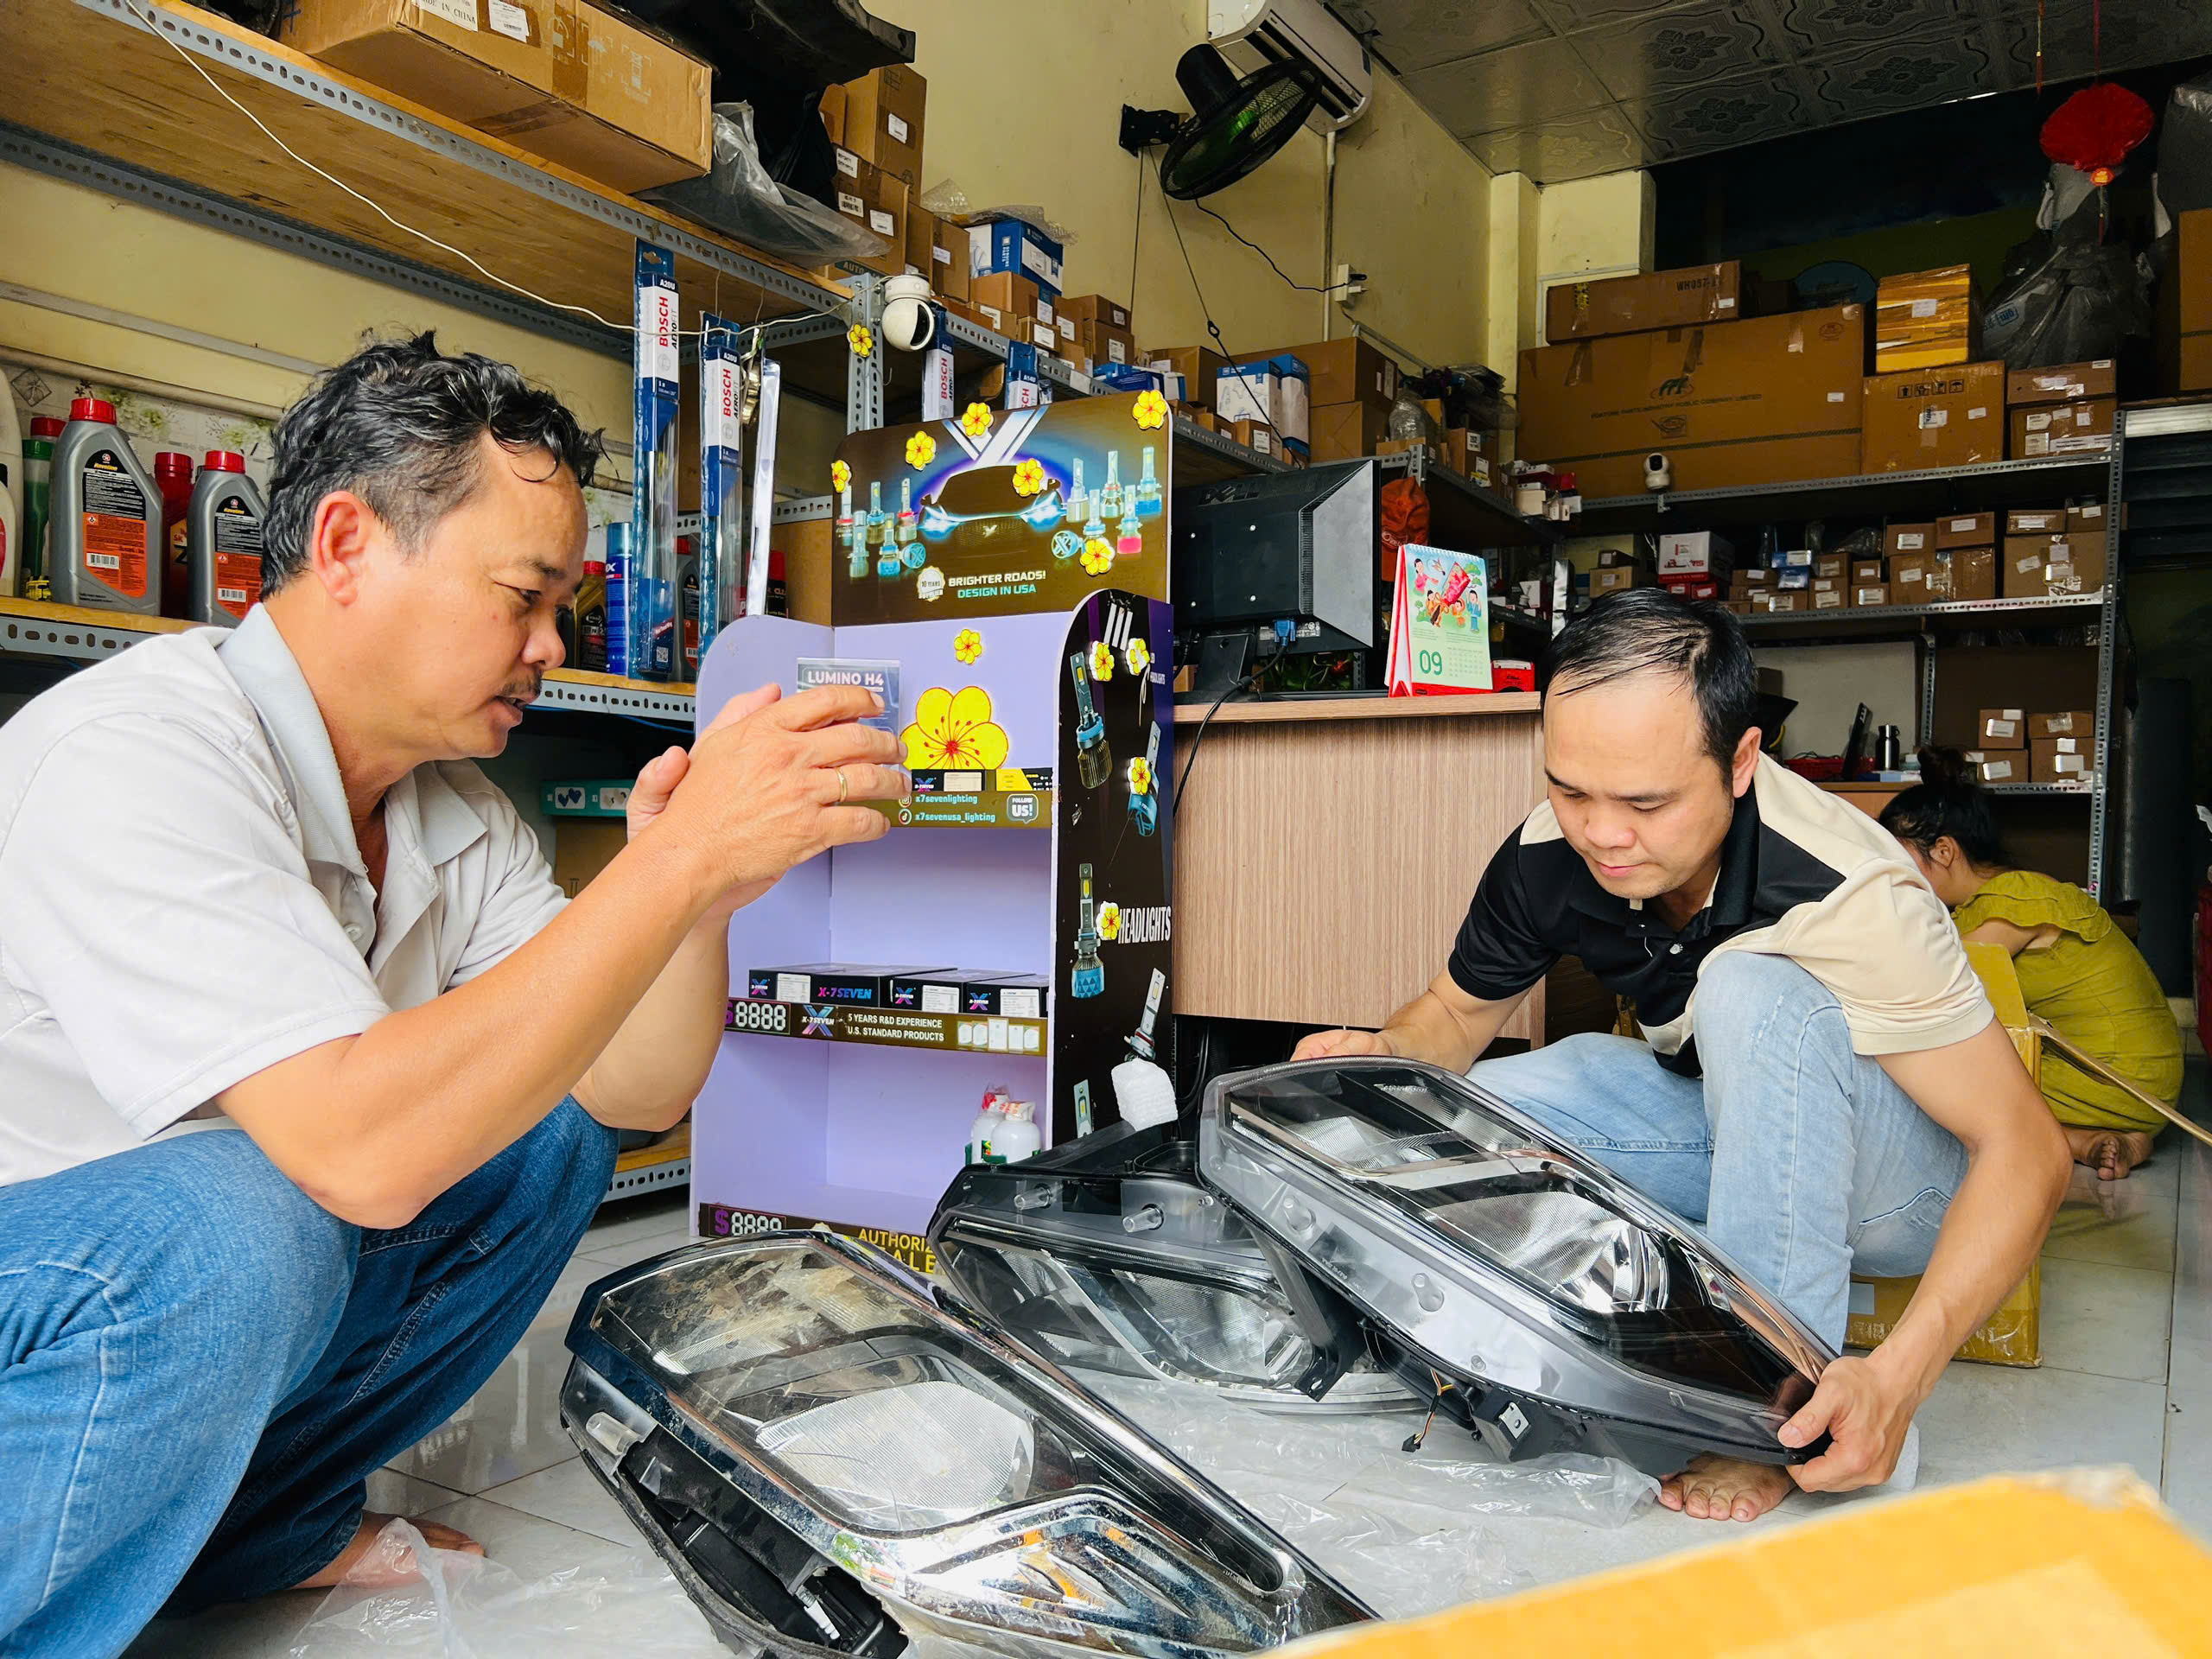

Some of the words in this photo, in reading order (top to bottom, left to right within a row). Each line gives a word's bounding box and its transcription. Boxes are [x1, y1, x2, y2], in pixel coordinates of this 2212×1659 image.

[454, 8, 476, 24] CHINA
[659, 277, 676, 291] A20U
[658, 296, 669, 347] BOSCH
[722, 368, 732, 417] BOSCH
[948, 574, 1002, 588] BRIGHTER
[1004, 569, 1046, 582] ROADS!
[957, 587, 998, 599] DESIGN
[1000, 586, 1011, 595] IN
[1014, 584, 1037, 594] USA
[1419, 649, 1443, 676] 09
[808, 671, 861, 685] LUMINO
[865, 673, 884, 686] H4
[915, 794, 978, 804] x7sevenlighting
[915, 812, 996, 823] x7sevenusa_lighting
[1011, 804, 1033, 817] US!
[1117, 906, 1172, 944] HEADLIGHTS
[818, 986, 873, 1000] X-7SEVEN
[848, 1013, 853, 1021] 5
[853, 1014, 878, 1024] YEARS
[879, 1015, 895, 1026] R&D
[896, 1016, 943, 1028] EXPERIENCE
[848, 1026, 861, 1035] U.S.
[862, 1027, 902, 1038] STANDARD
[903, 1031, 944, 1042] PRODUCTS
